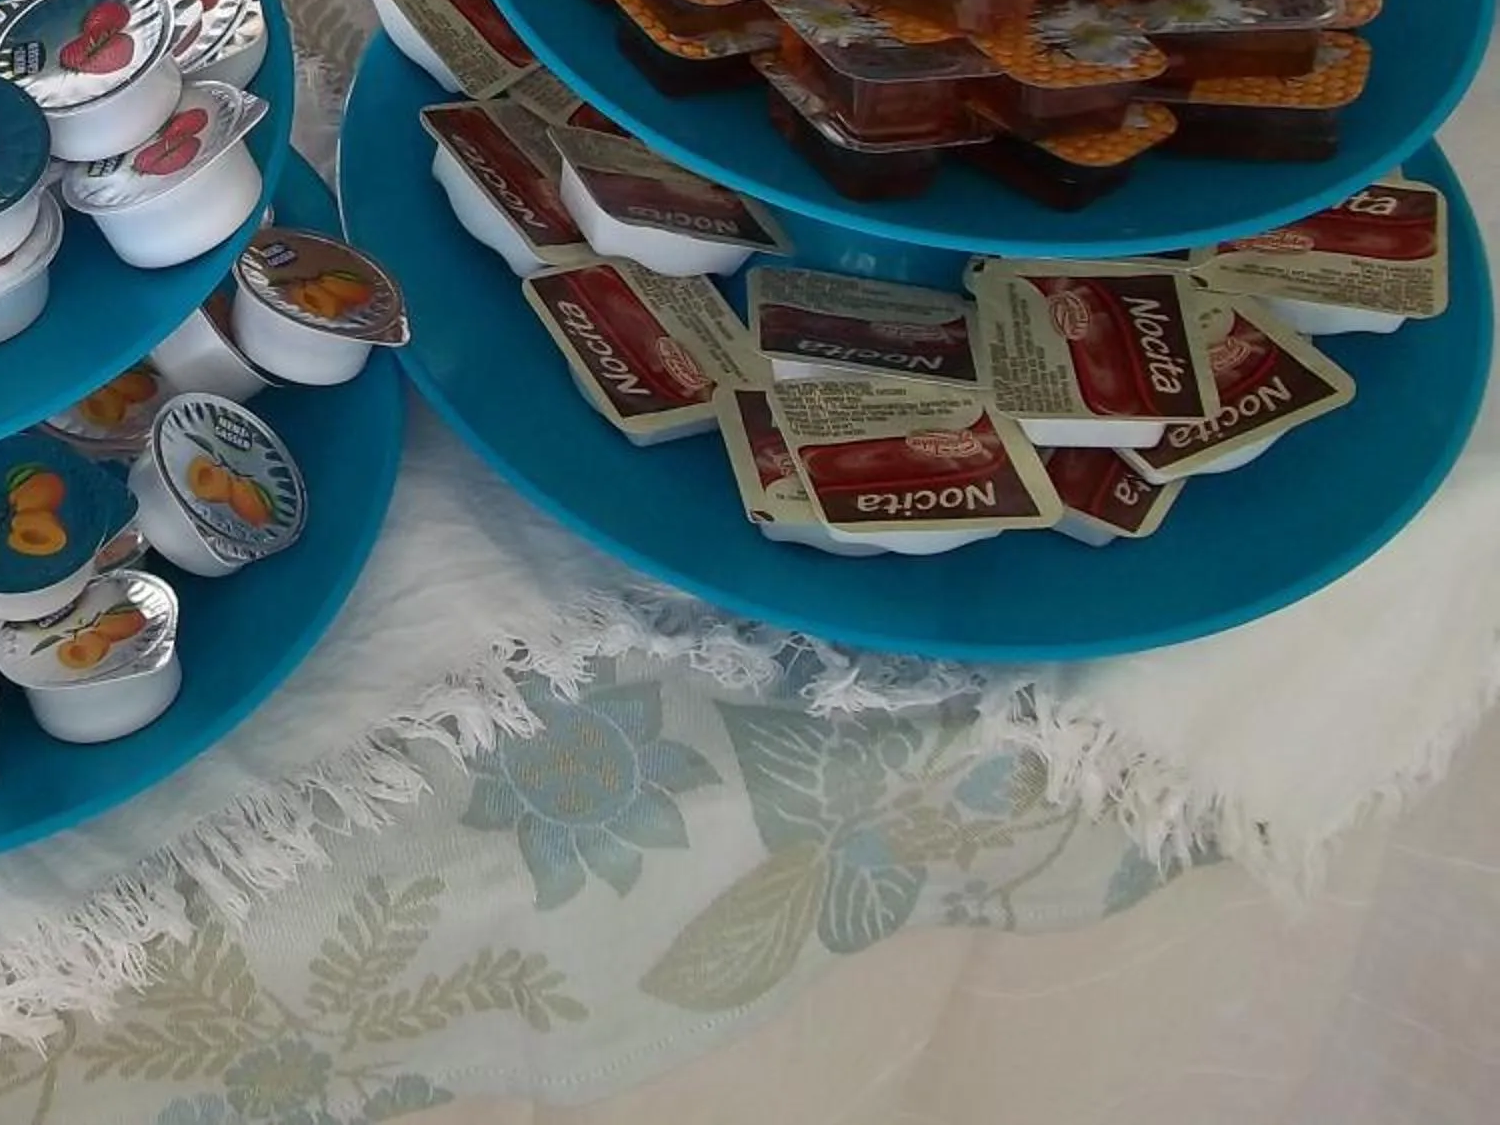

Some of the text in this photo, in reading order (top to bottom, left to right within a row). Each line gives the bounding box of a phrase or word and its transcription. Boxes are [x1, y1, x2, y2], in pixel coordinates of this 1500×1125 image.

[558, 300, 652, 397] Nocita
[799, 339, 944, 371] Nocita
[1123, 294, 1182, 395] Nocita
[1169, 375, 1293, 450] Nocita
[856, 479, 997, 517] Nocita
